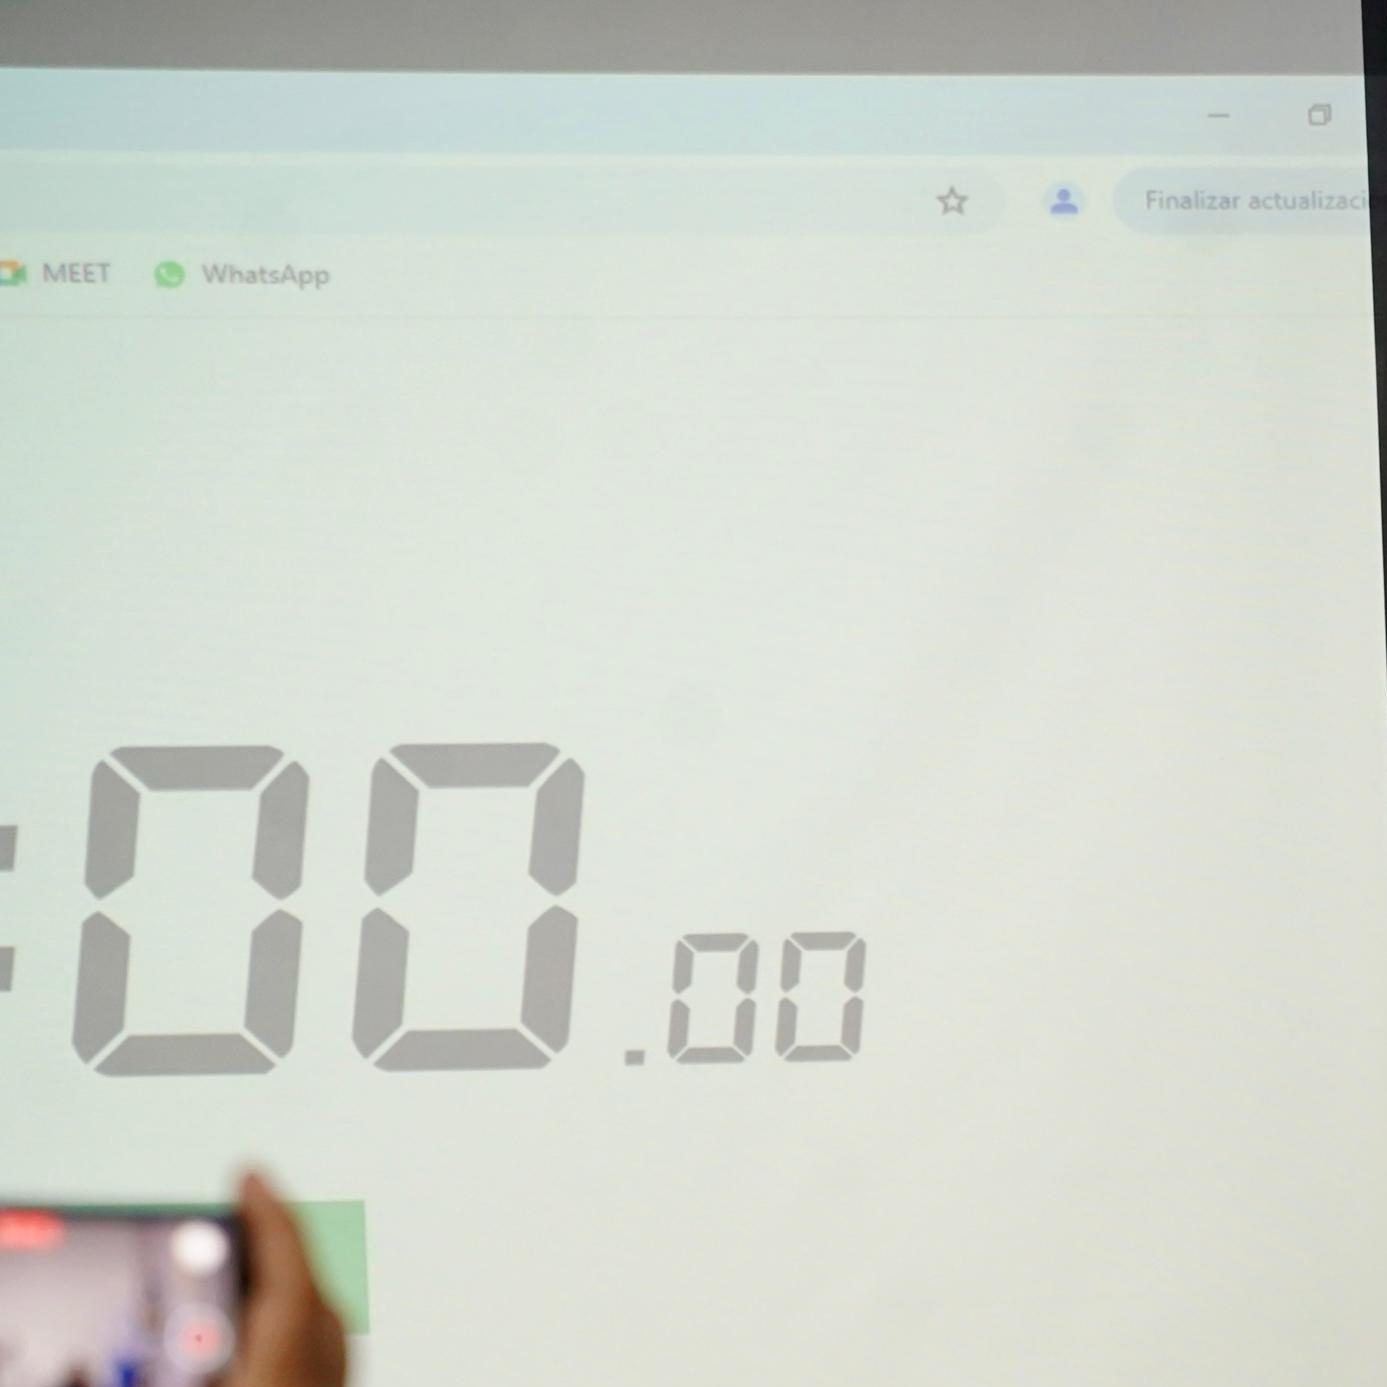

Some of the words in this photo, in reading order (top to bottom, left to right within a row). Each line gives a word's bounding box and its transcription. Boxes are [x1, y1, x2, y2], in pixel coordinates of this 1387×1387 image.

[1145, 189, 1239, 211] Finalizar
[1247, 189, 1369, 211] actualizaci
[42, 262, 111, 284] MEET
[202, 263, 331, 291] WhatsApp
